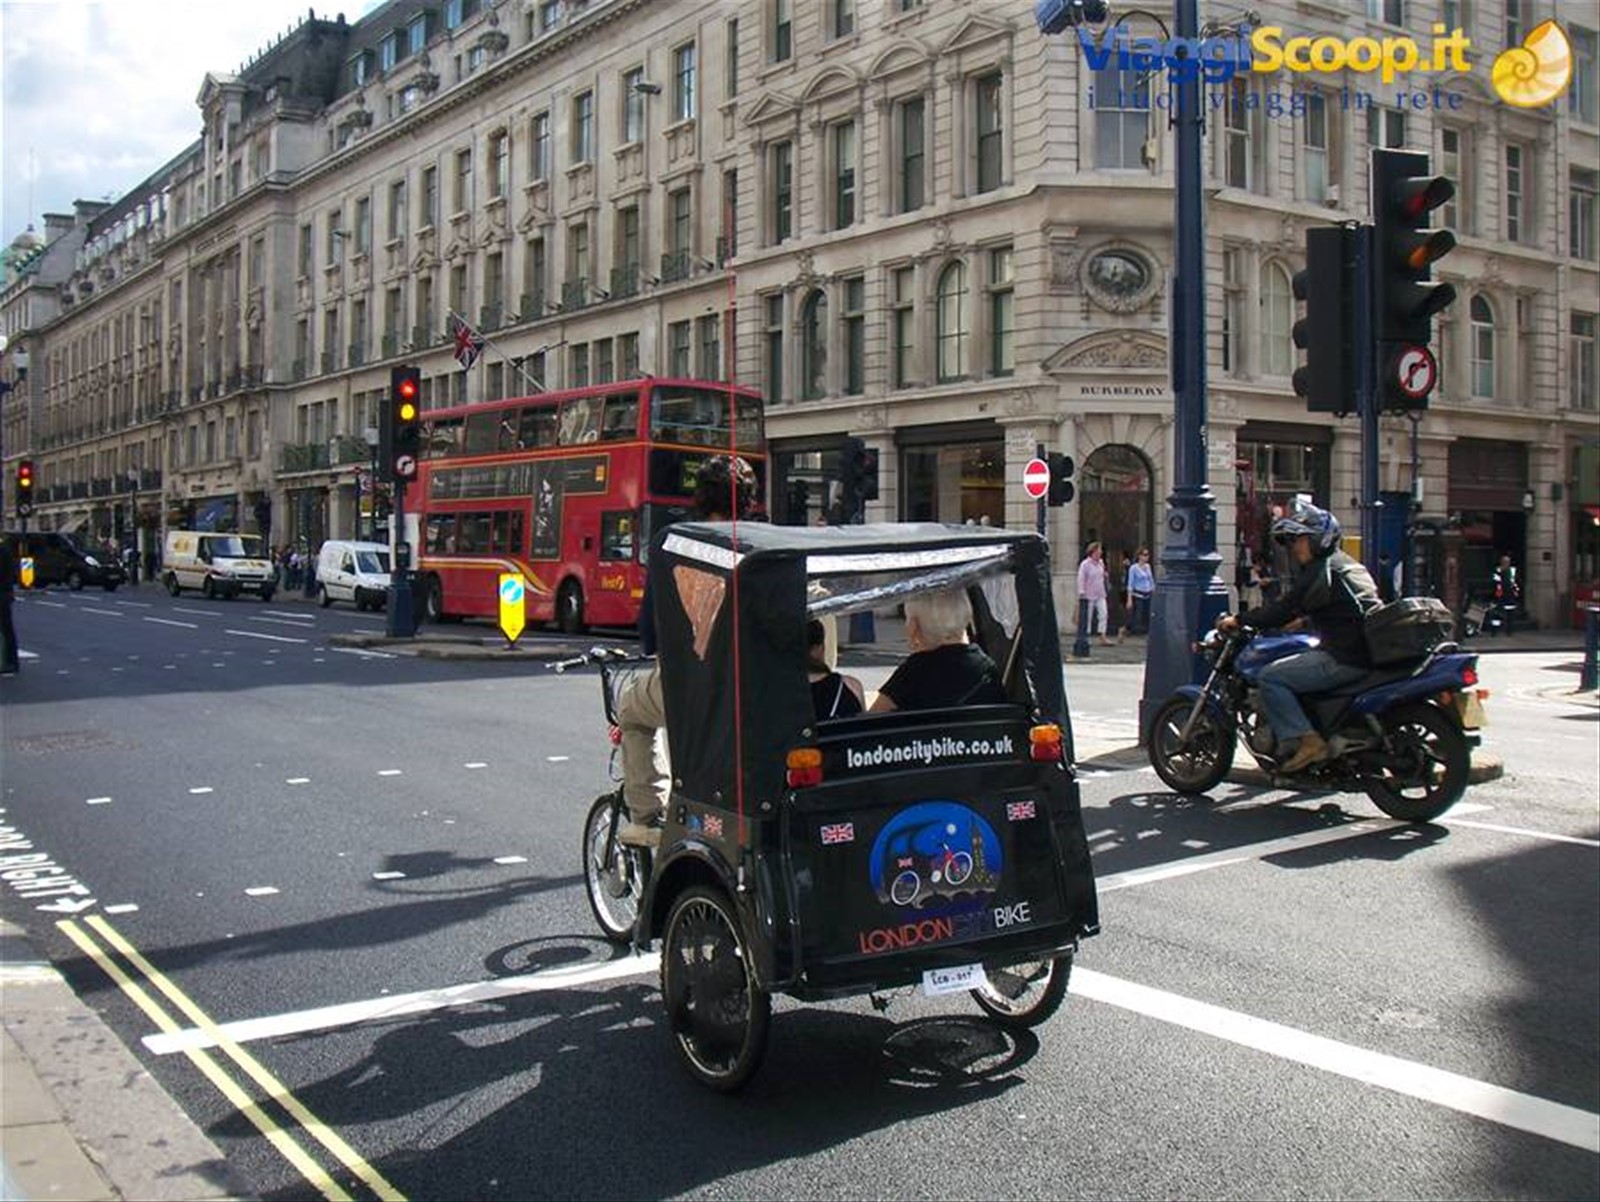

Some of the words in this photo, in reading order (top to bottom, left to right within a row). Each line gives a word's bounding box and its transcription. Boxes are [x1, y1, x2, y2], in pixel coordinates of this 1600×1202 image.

[1081, 386, 1165, 395] BURBERRY
[847, 734, 1013, 768] londoncitybike.co.uk
[859, 918, 953, 954] LONDON
[994, 902, 1031, 928] BIKE
